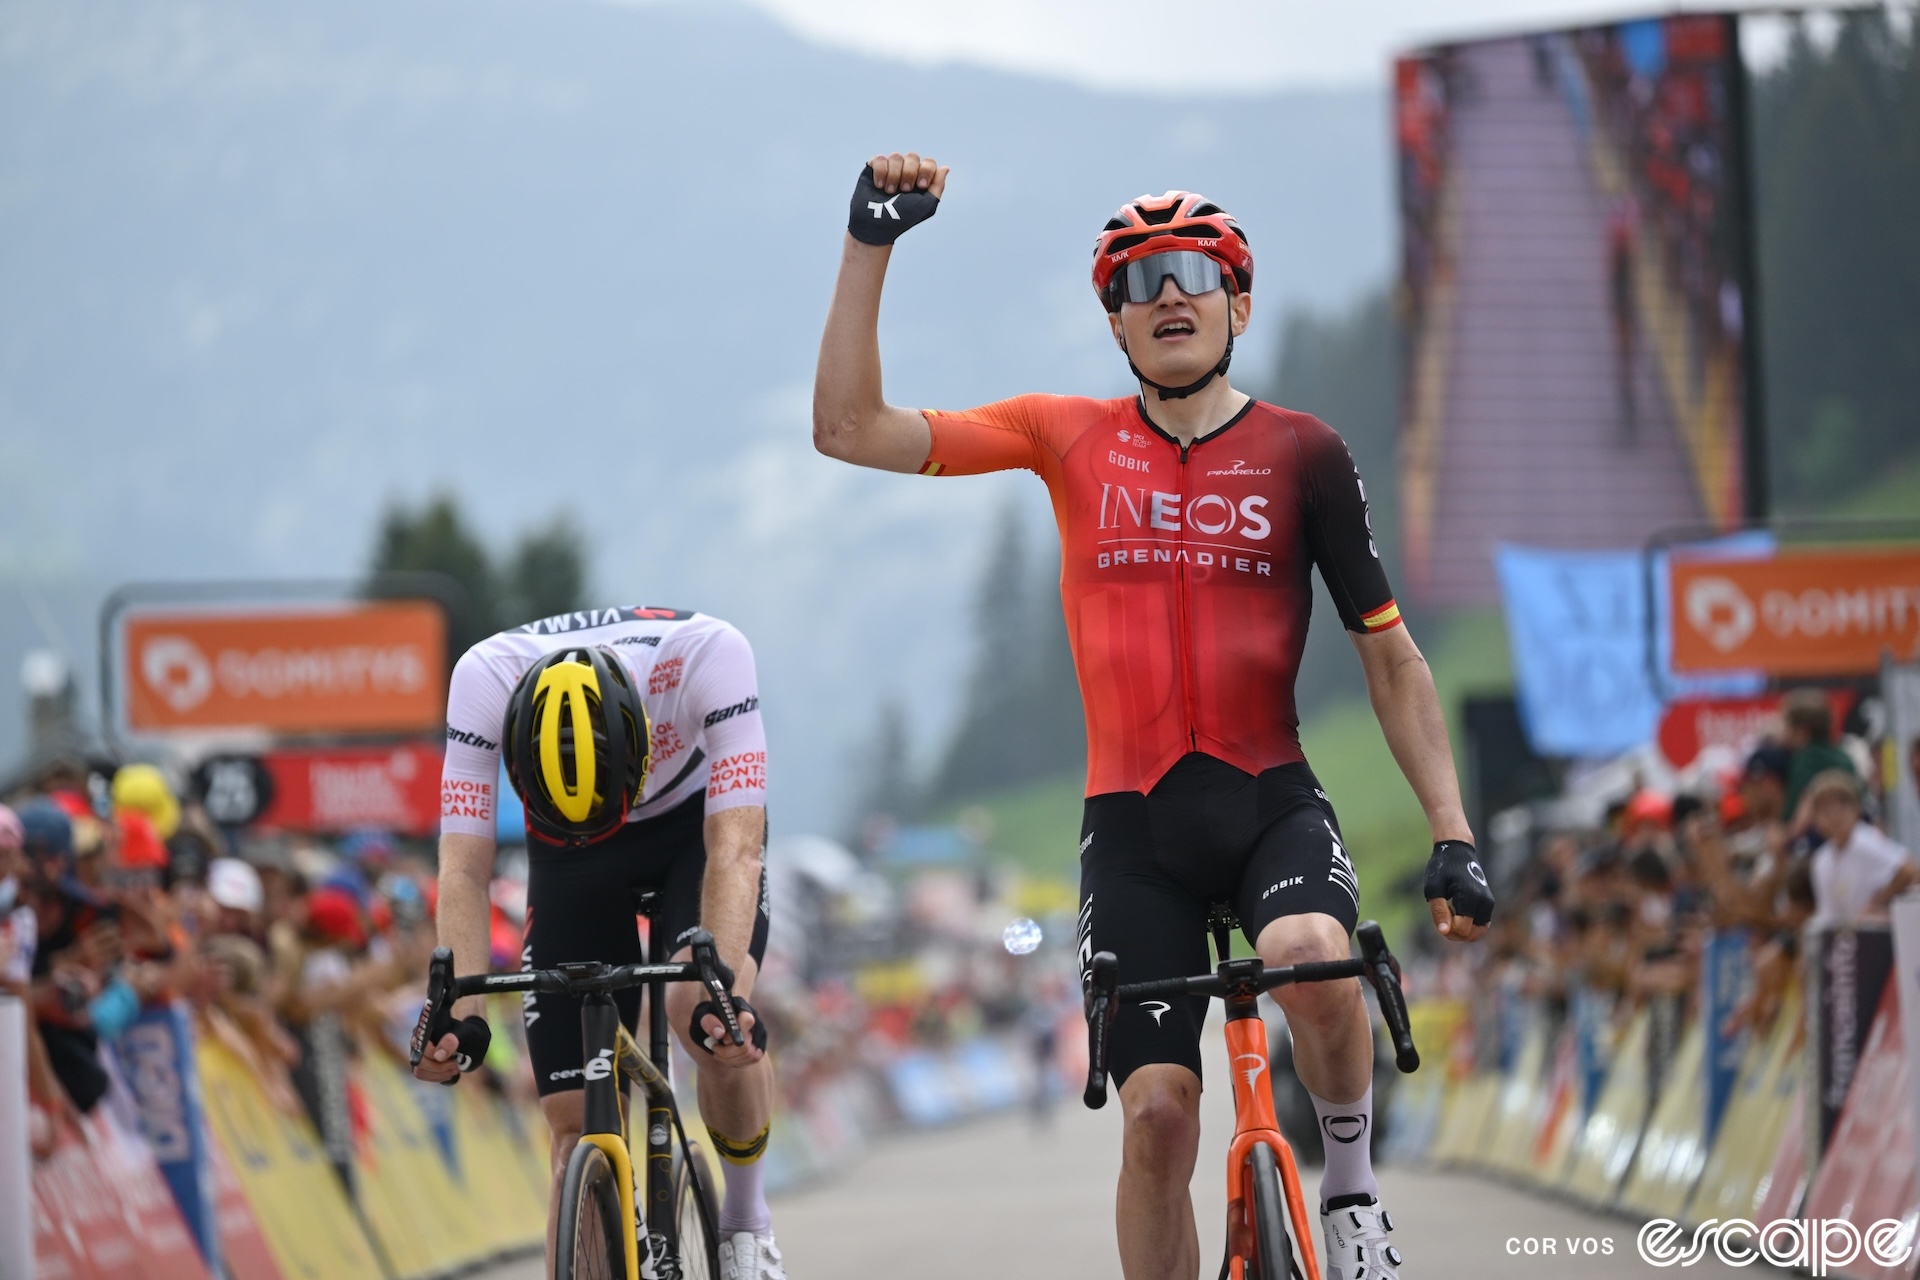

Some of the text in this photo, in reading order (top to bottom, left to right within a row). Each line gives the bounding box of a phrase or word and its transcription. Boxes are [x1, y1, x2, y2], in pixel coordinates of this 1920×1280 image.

[1111, 251, 1129, 263] KASK
[1108, 450, 1150, 473] GOBIK
[1206, 464, 1272, 477] PINARELLO
[1097, 482, 1271, 541] INEOS
[1097, 548, 1272, 577] GRENADIER
[520, 607, 622, 635] VISMA
[711, 752, 766, 774] SAVOIE
[709, 765, 759, 787] MONT
[442, 780, 491, 796] AVOIE
[442, 793, 479, 805] ONT
[708, 777, 766, 799] BLANC
[1262, 875, 1304, 900] GOBIK
